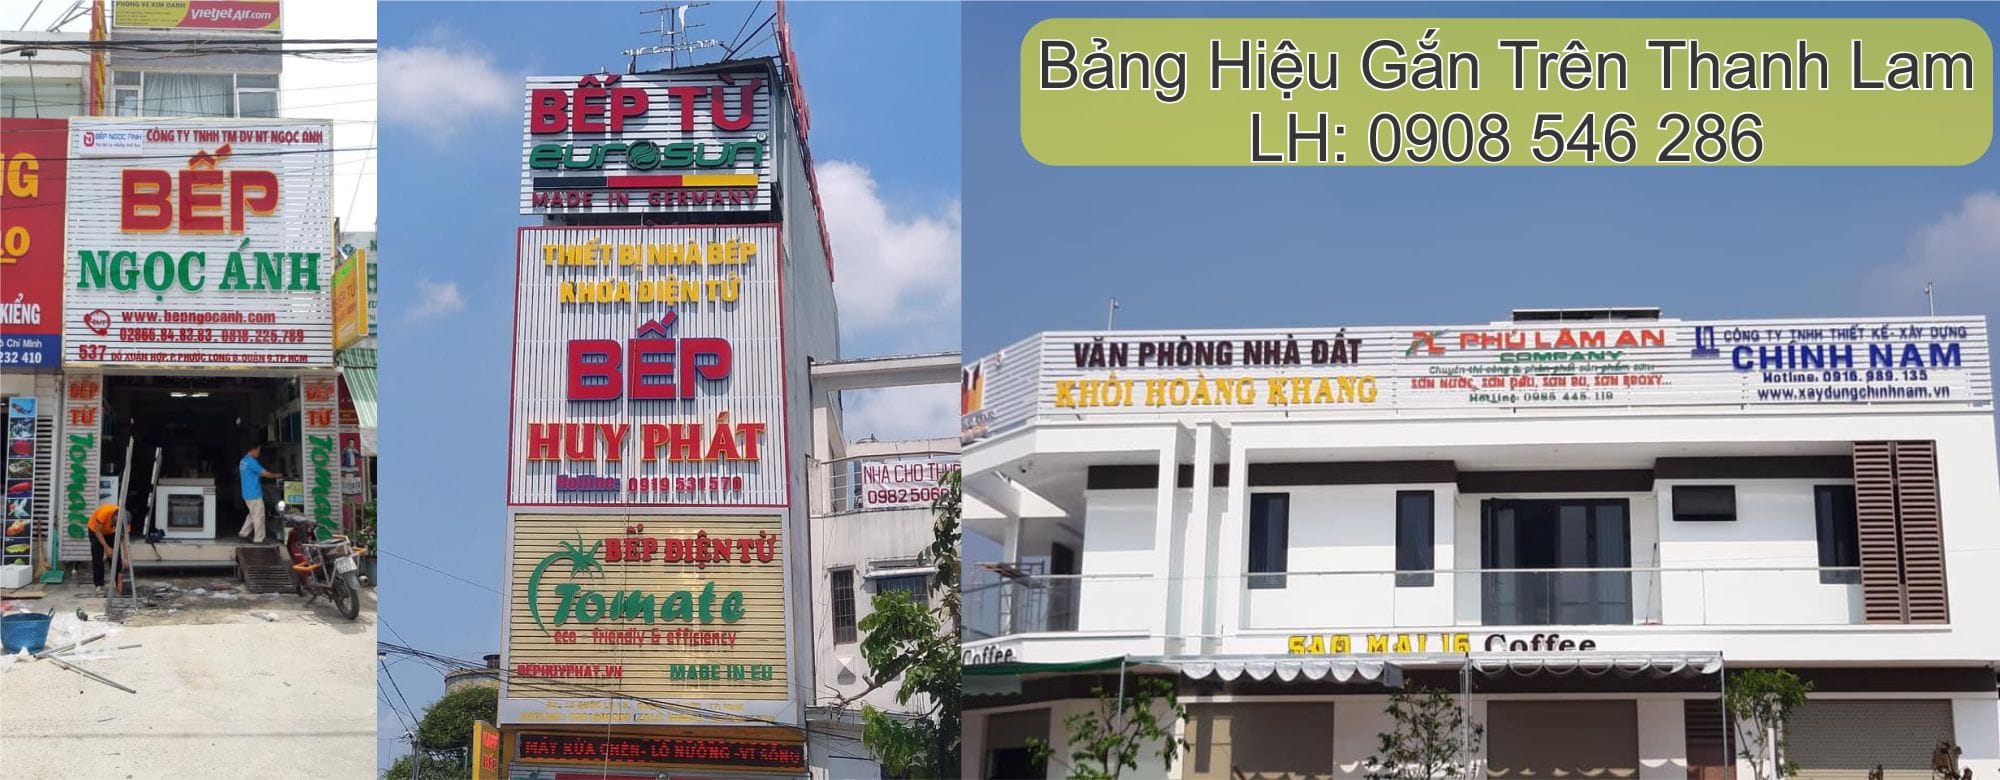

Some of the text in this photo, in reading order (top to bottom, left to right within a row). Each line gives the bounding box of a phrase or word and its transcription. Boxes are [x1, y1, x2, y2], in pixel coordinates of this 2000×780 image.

[531, 73, 762, 134] BẾP TỪ
[146, 127, 174, 142] CÔNG
[177, 130, 190, 142] TY
[193, 130, 219, 143] TNHH
[222, 130, 236, 143] TM
[256, 131, 268, 144] NT
[271, 131, 299, 145] NGỌC
[120, 144, 280, 235] BẾP
[532, 188, 758, 208] MADE IN GERMANY
[543, 234, 757, 272] THIẾT BỊ NHÀ BẾP
[77, 249, 206, 301] NGỌC
[218, 238, 321, 292] ÁNH
[121, 310, 276, 325] www.bepngocanh.com
[1459, 328, 1665, 349] PHÚ LÂM AN
[1723, 327, 1760, 342] CÔNG
[1766, 329, 1782, 341] TY
[1789, 328, 1823, 341] TNHH
[1830, 323, 1865, 339] THIẾT
[1900, 325, 1923, 339] XÂY
[1930, 325, 1967, 341] DỰNG
[23, 339, 42, 349] Minh
[79, 344, 107, 360] 537
[1074, 328, 1362, 367] VĂN PHÒNG NHÀ ĐẤT
[21, 353, 42, 364] 410
[568, 310, 733, 401] BẾP
[1500, 350, 1624, 362] COMPANY
[1732, 340, 1961, 370] CHÍNH NAM
[1145, 371, 1256, 407] HOÀNG
[1267, 375, 1377, 406] KHANG
[527, 411, 766, 462] HUY PHÁT
[894, 463, 924, 483] CHO
[628, 477, 670, 492] 0919
[868, 489, 907, 504] 0982
[605, 523, 658, 563] BẾP
[552, 581, 746, 626] Tomate
[554, 630, 576, 644] eco
[592, 628, 645, 648] friendly
[667, 628, 737, 649] efficiency
[1288, 634, 1351, 655] SAO
[1367, 634, 1427, 655] MAI
[1484, 634, 1598, 652] Coffee
[962, 645, 1013, 665] Coffee
[670, 664, 773, 681] MADE IN EU
